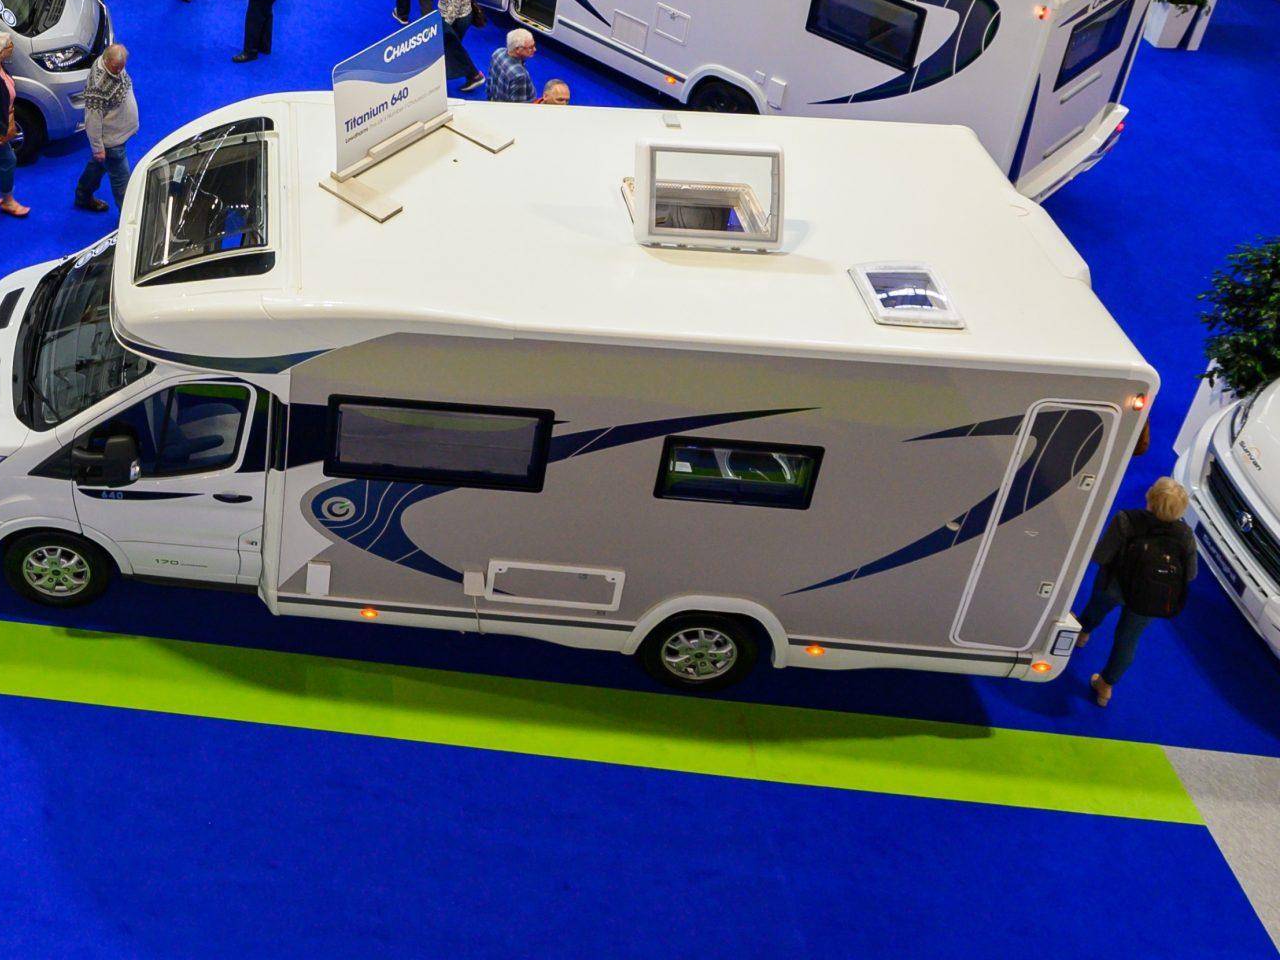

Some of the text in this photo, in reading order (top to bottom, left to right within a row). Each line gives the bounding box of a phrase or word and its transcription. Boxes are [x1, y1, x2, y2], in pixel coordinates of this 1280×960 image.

[383, 24, 438, 63] CHAUSSON
[344, 99, 388, 133] Titanium
[390, 86, 409, 107] 640
